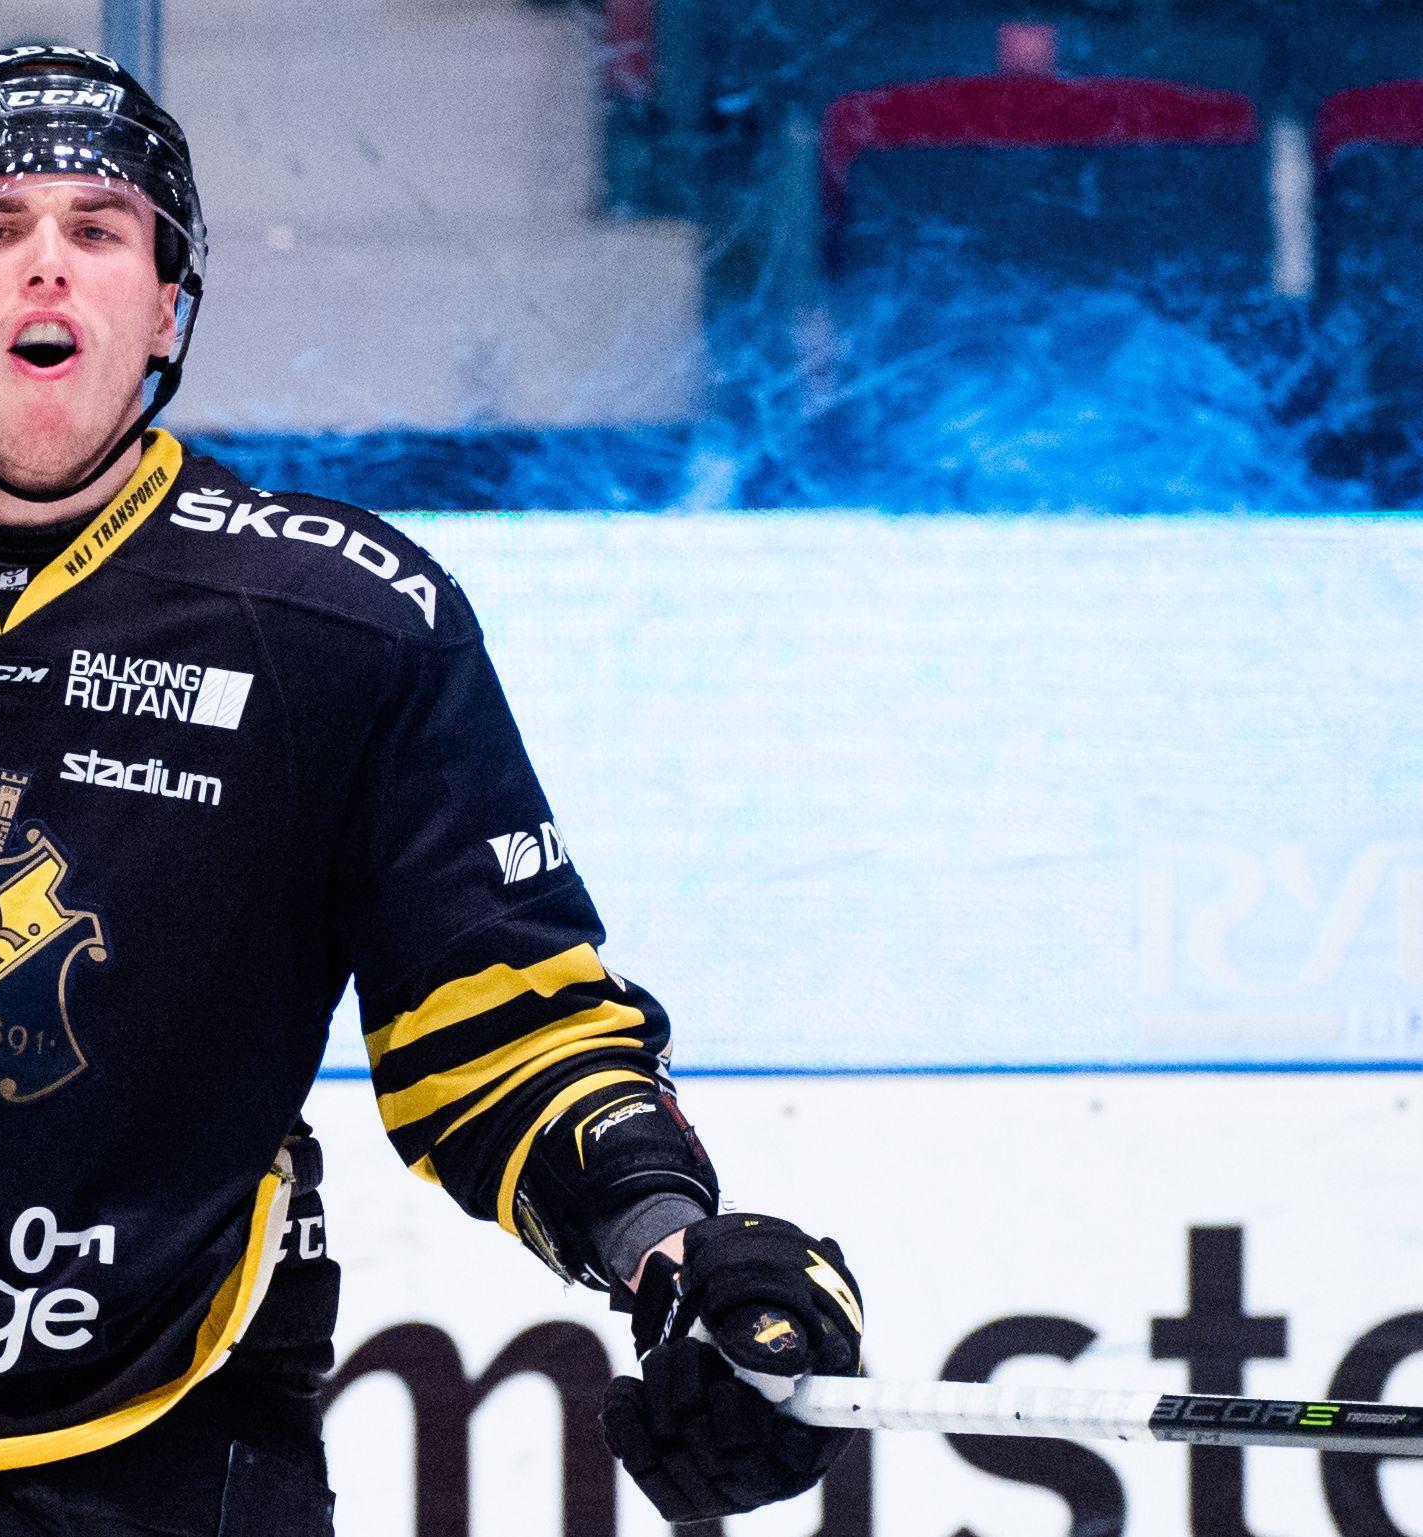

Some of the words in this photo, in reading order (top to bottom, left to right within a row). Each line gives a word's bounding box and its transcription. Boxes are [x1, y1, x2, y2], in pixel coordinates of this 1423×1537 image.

[7, 89, 108, 107] CCM
[92, 466, 168, 549] TRANSPORTER
[169, 486, 437, 630] ŠKODA
[70, 649, 201, 691] BALKONG
[64, 675, 191, 722] RUTAN
[60, 750, 221, 806] stadium
[590, 1103, 657, 1141] TACKS
